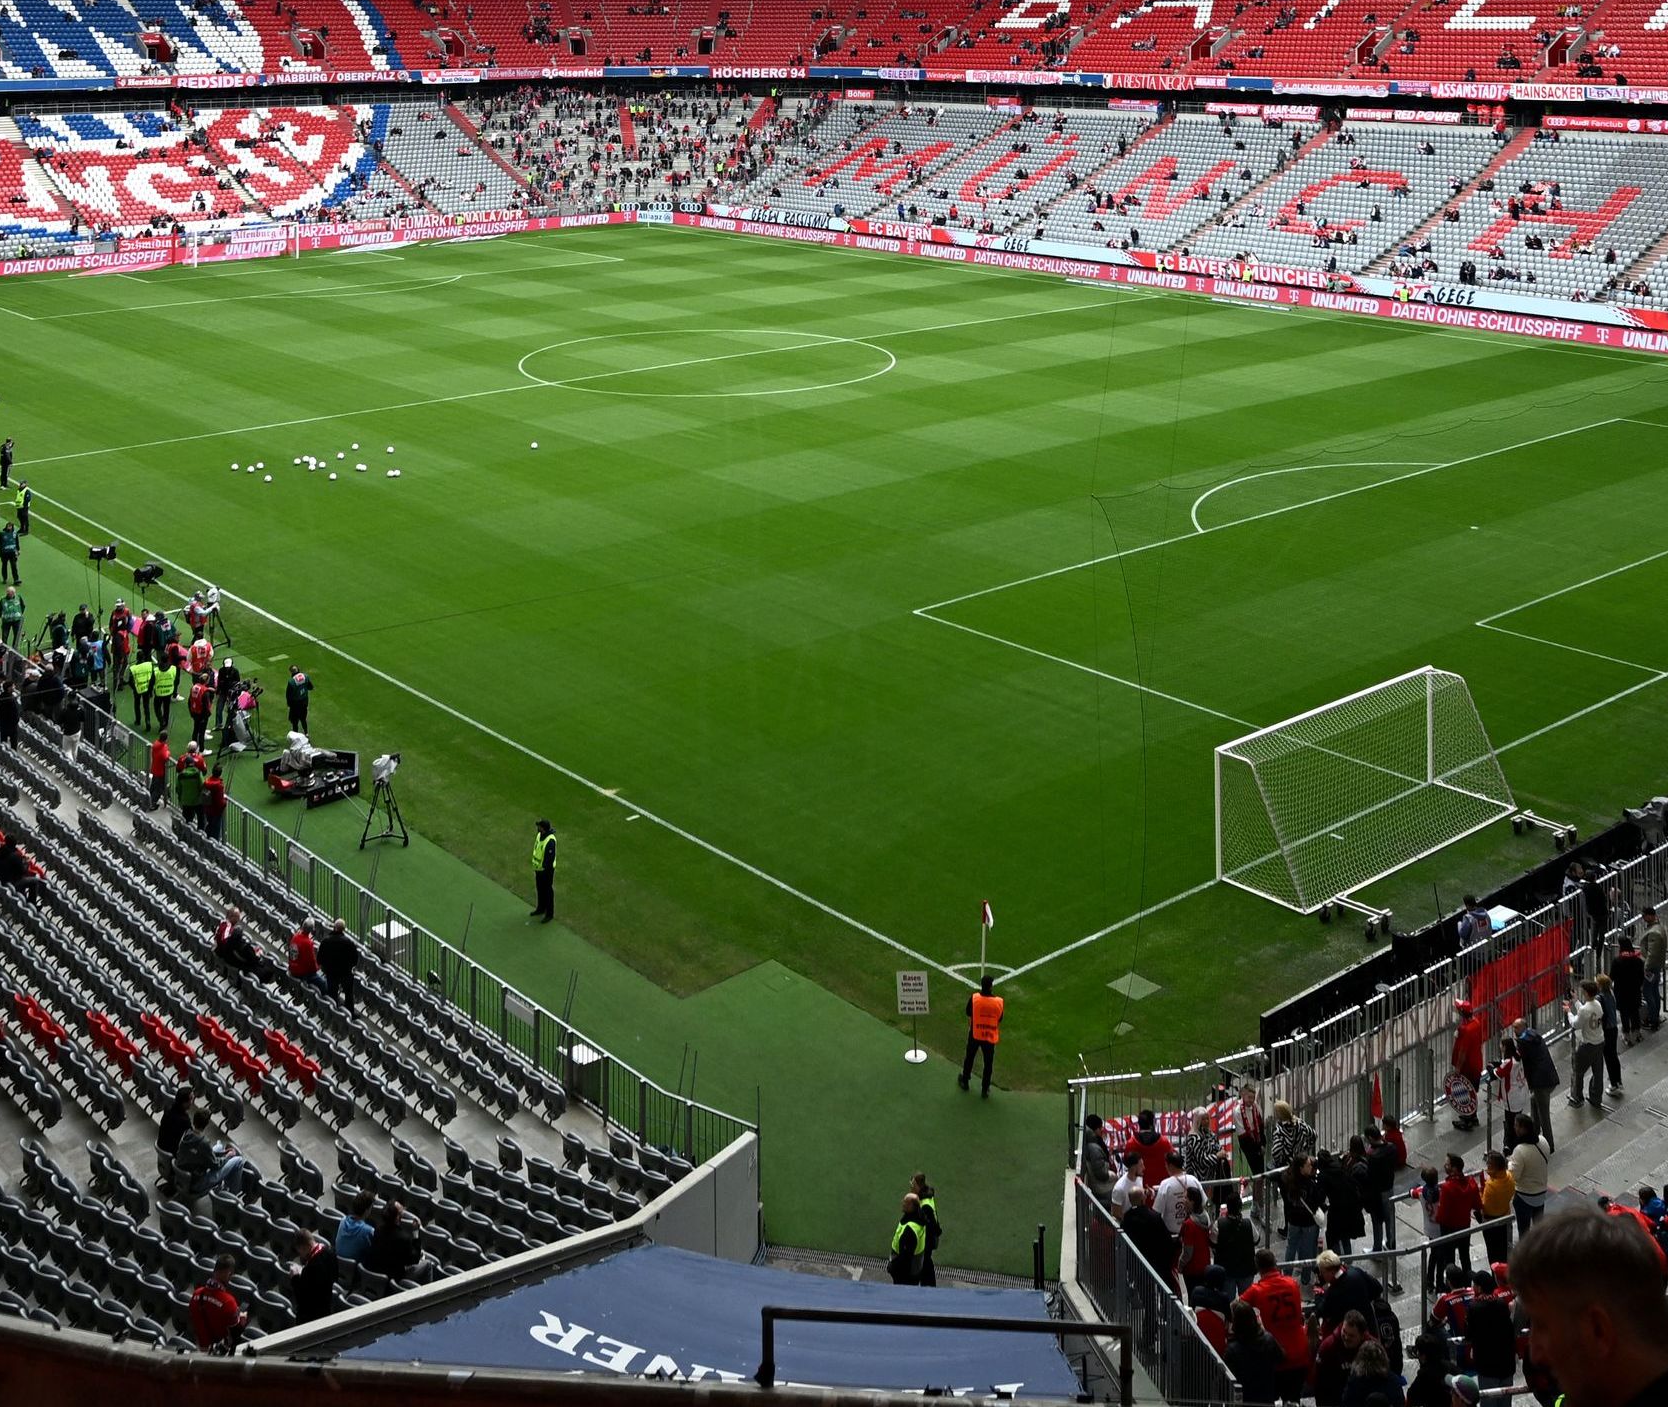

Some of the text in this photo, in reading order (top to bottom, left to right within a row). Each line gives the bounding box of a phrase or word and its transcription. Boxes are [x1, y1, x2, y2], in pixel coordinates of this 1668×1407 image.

[276, 73, 327, 83] NABBURG
[336, 70, 396, 82] OBERPFALZ
[551, 67, 604, 78] Geisenfeld
[177, 75, 245, 89] REDSIDE
[847, 89, 871, 98] Böhen
[1437, 82, 1503, 100] ASSAMSTADT
[1515, 84, 1584, 100] HAINSACKER
[1394, 109, 1415, 120] RED
[1569, 118, 1624, 128] Audi Fanclub
[390, 214, 454, 231] NEUMARKT
[560, 214, 610, 227] UNLIMITED
[700, 217, 736, 231] UNLIMITED
[403, 219, 529, 241] DATEN OHNE SCHLUSSPFIFF
[741, 223, 837, 244] DATEN OHNE SCHLUSSPFIFF
[868, 222, 932, 240] FC BAYERN
[226, 239, 288, 256] UNLIMITED
[339, 232, 394, 246] UNLIMITED
[856, 237, 900, 252] UNLIMITED
[920, 245, 966, 260] UNLIMITED
[3, 250, 168, 275] DATEN OHNE SCHLUSSPFIFF
[974, 250, 1100, 278] DATEN OHNE SCHLUSSPFIFF
[1155, 254, 1175, 271] FC
[1178, 256, 1241, 279] BAYERN
[1127, 269, 1187, 288] UNLIMITED
[1214, 279, 1278, 301] UNLIMITED
[1437, 286, 1476, 305] GEGE
[1311, 292, 1380, 315] UNLIMITED
[1391, 303, 1584, 340] DATEN OHNE SCHLUSSPFIFF
